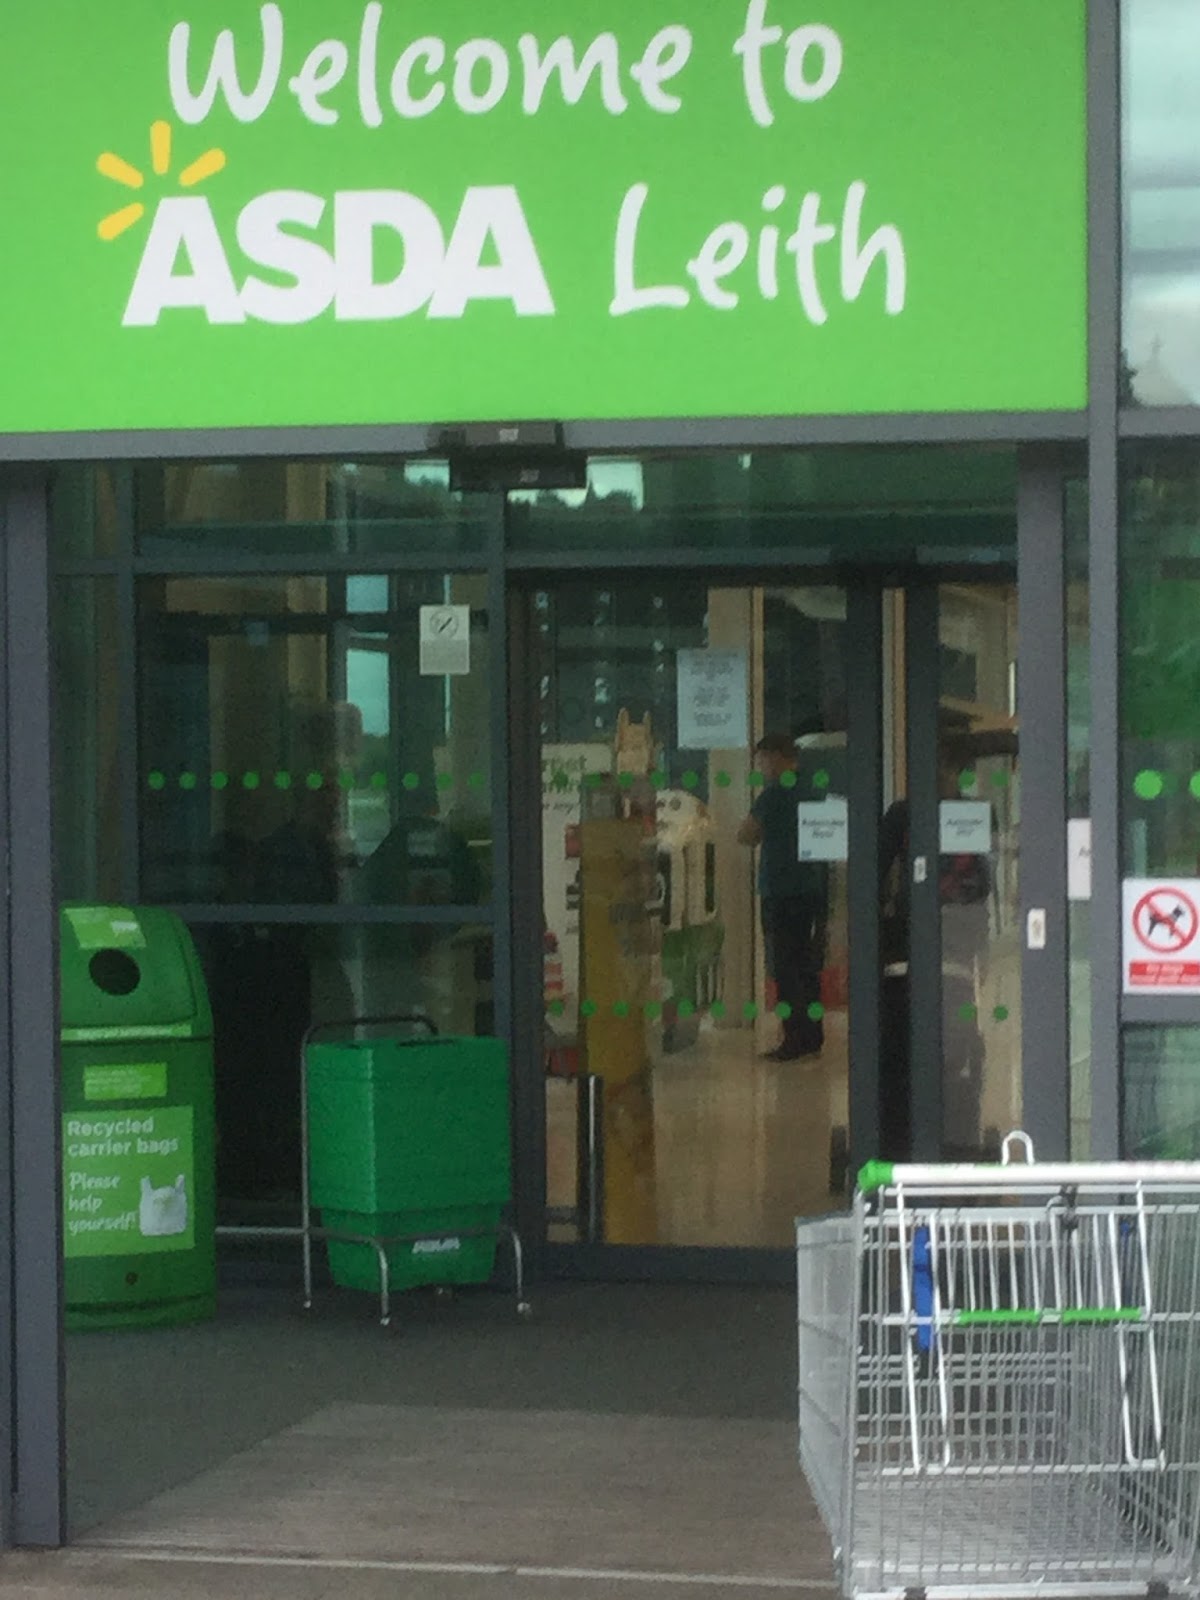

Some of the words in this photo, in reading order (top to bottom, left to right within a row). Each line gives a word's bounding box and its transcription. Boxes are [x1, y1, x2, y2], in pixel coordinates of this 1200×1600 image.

[167, 2, 693, 127] Welcome
[732, 0, 843, 127] to
[121, 184, 556, 328] ASDA
[608, 180, 907, 326] Leith
[67, 1116, 154, 1137] Recycled
[67, 1140, 131, 1157] carrier
[136, 1137, 179, 1155] bags
[69, 1171, 120, 1190] Please
[68, 1194, 103, 1213] help
